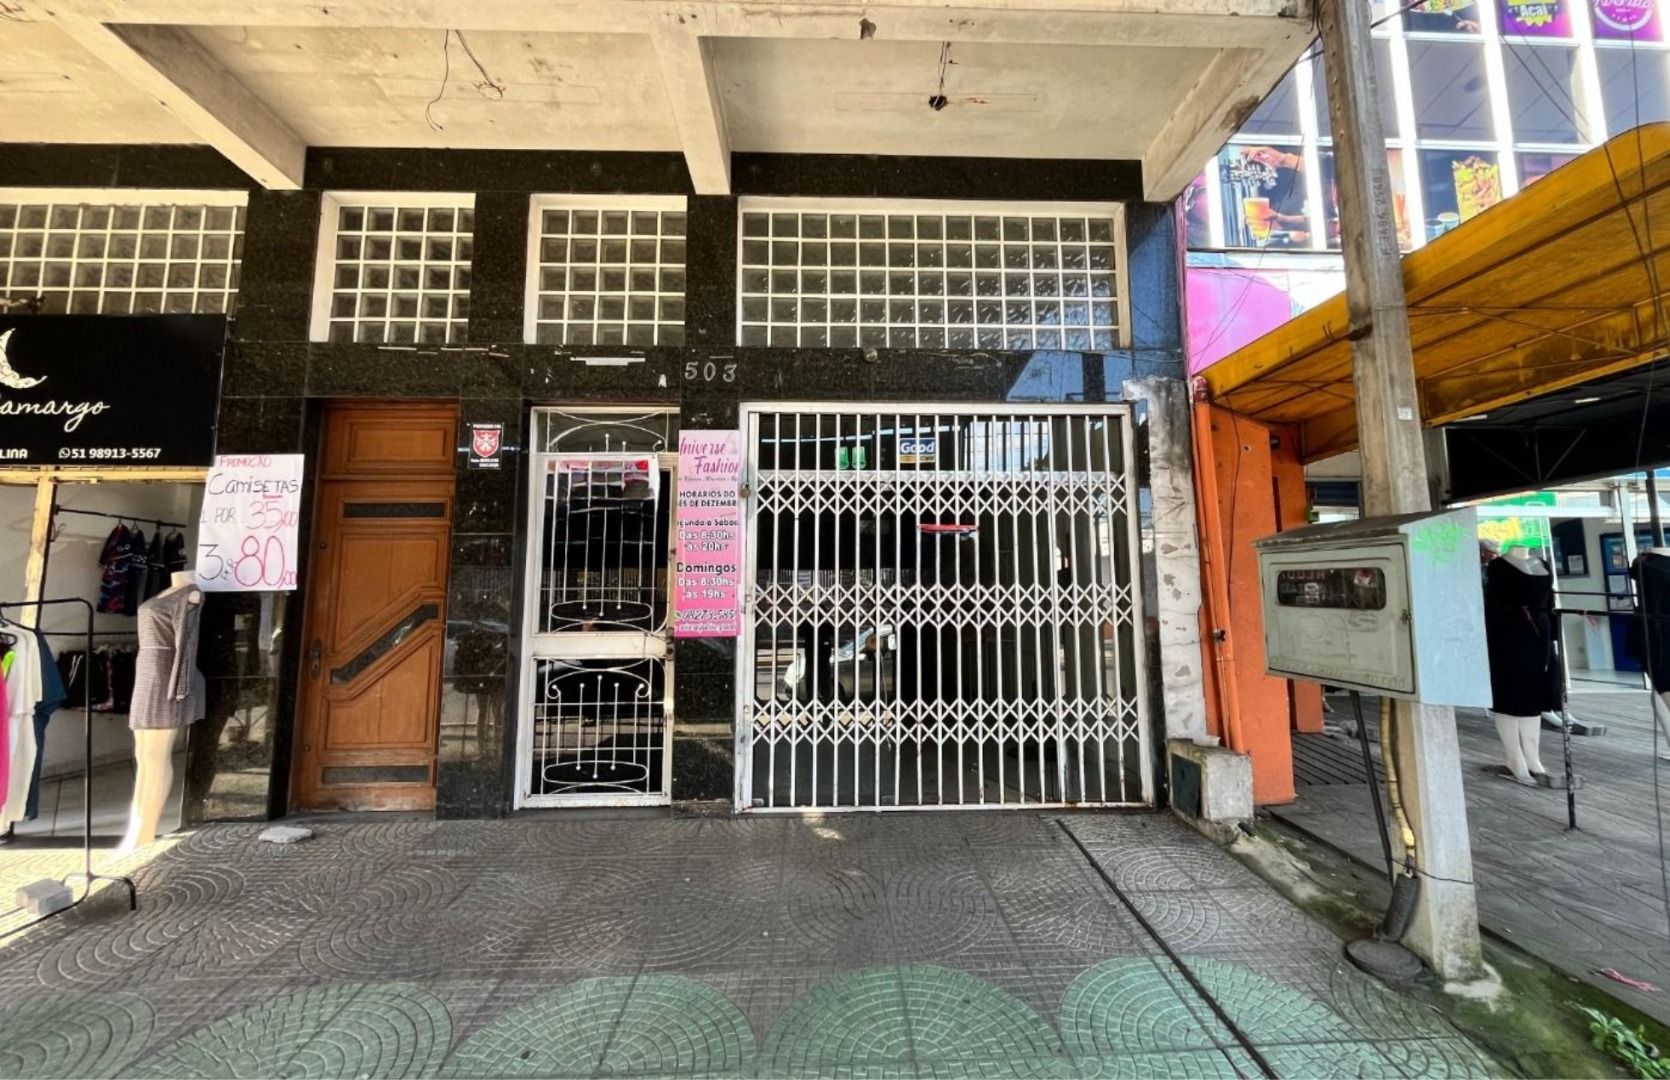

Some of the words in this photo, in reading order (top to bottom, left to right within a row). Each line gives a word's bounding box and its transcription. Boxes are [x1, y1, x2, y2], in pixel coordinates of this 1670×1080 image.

[684, 361, 738, 383] 503
[71, 448, 86, 459] 51
[89, 447, 162, 459] 98913-5567
[900, 441, 936, 454] Good
[199, 543, 224, 581] 3
[676, 561, 736, 575] Domingos
